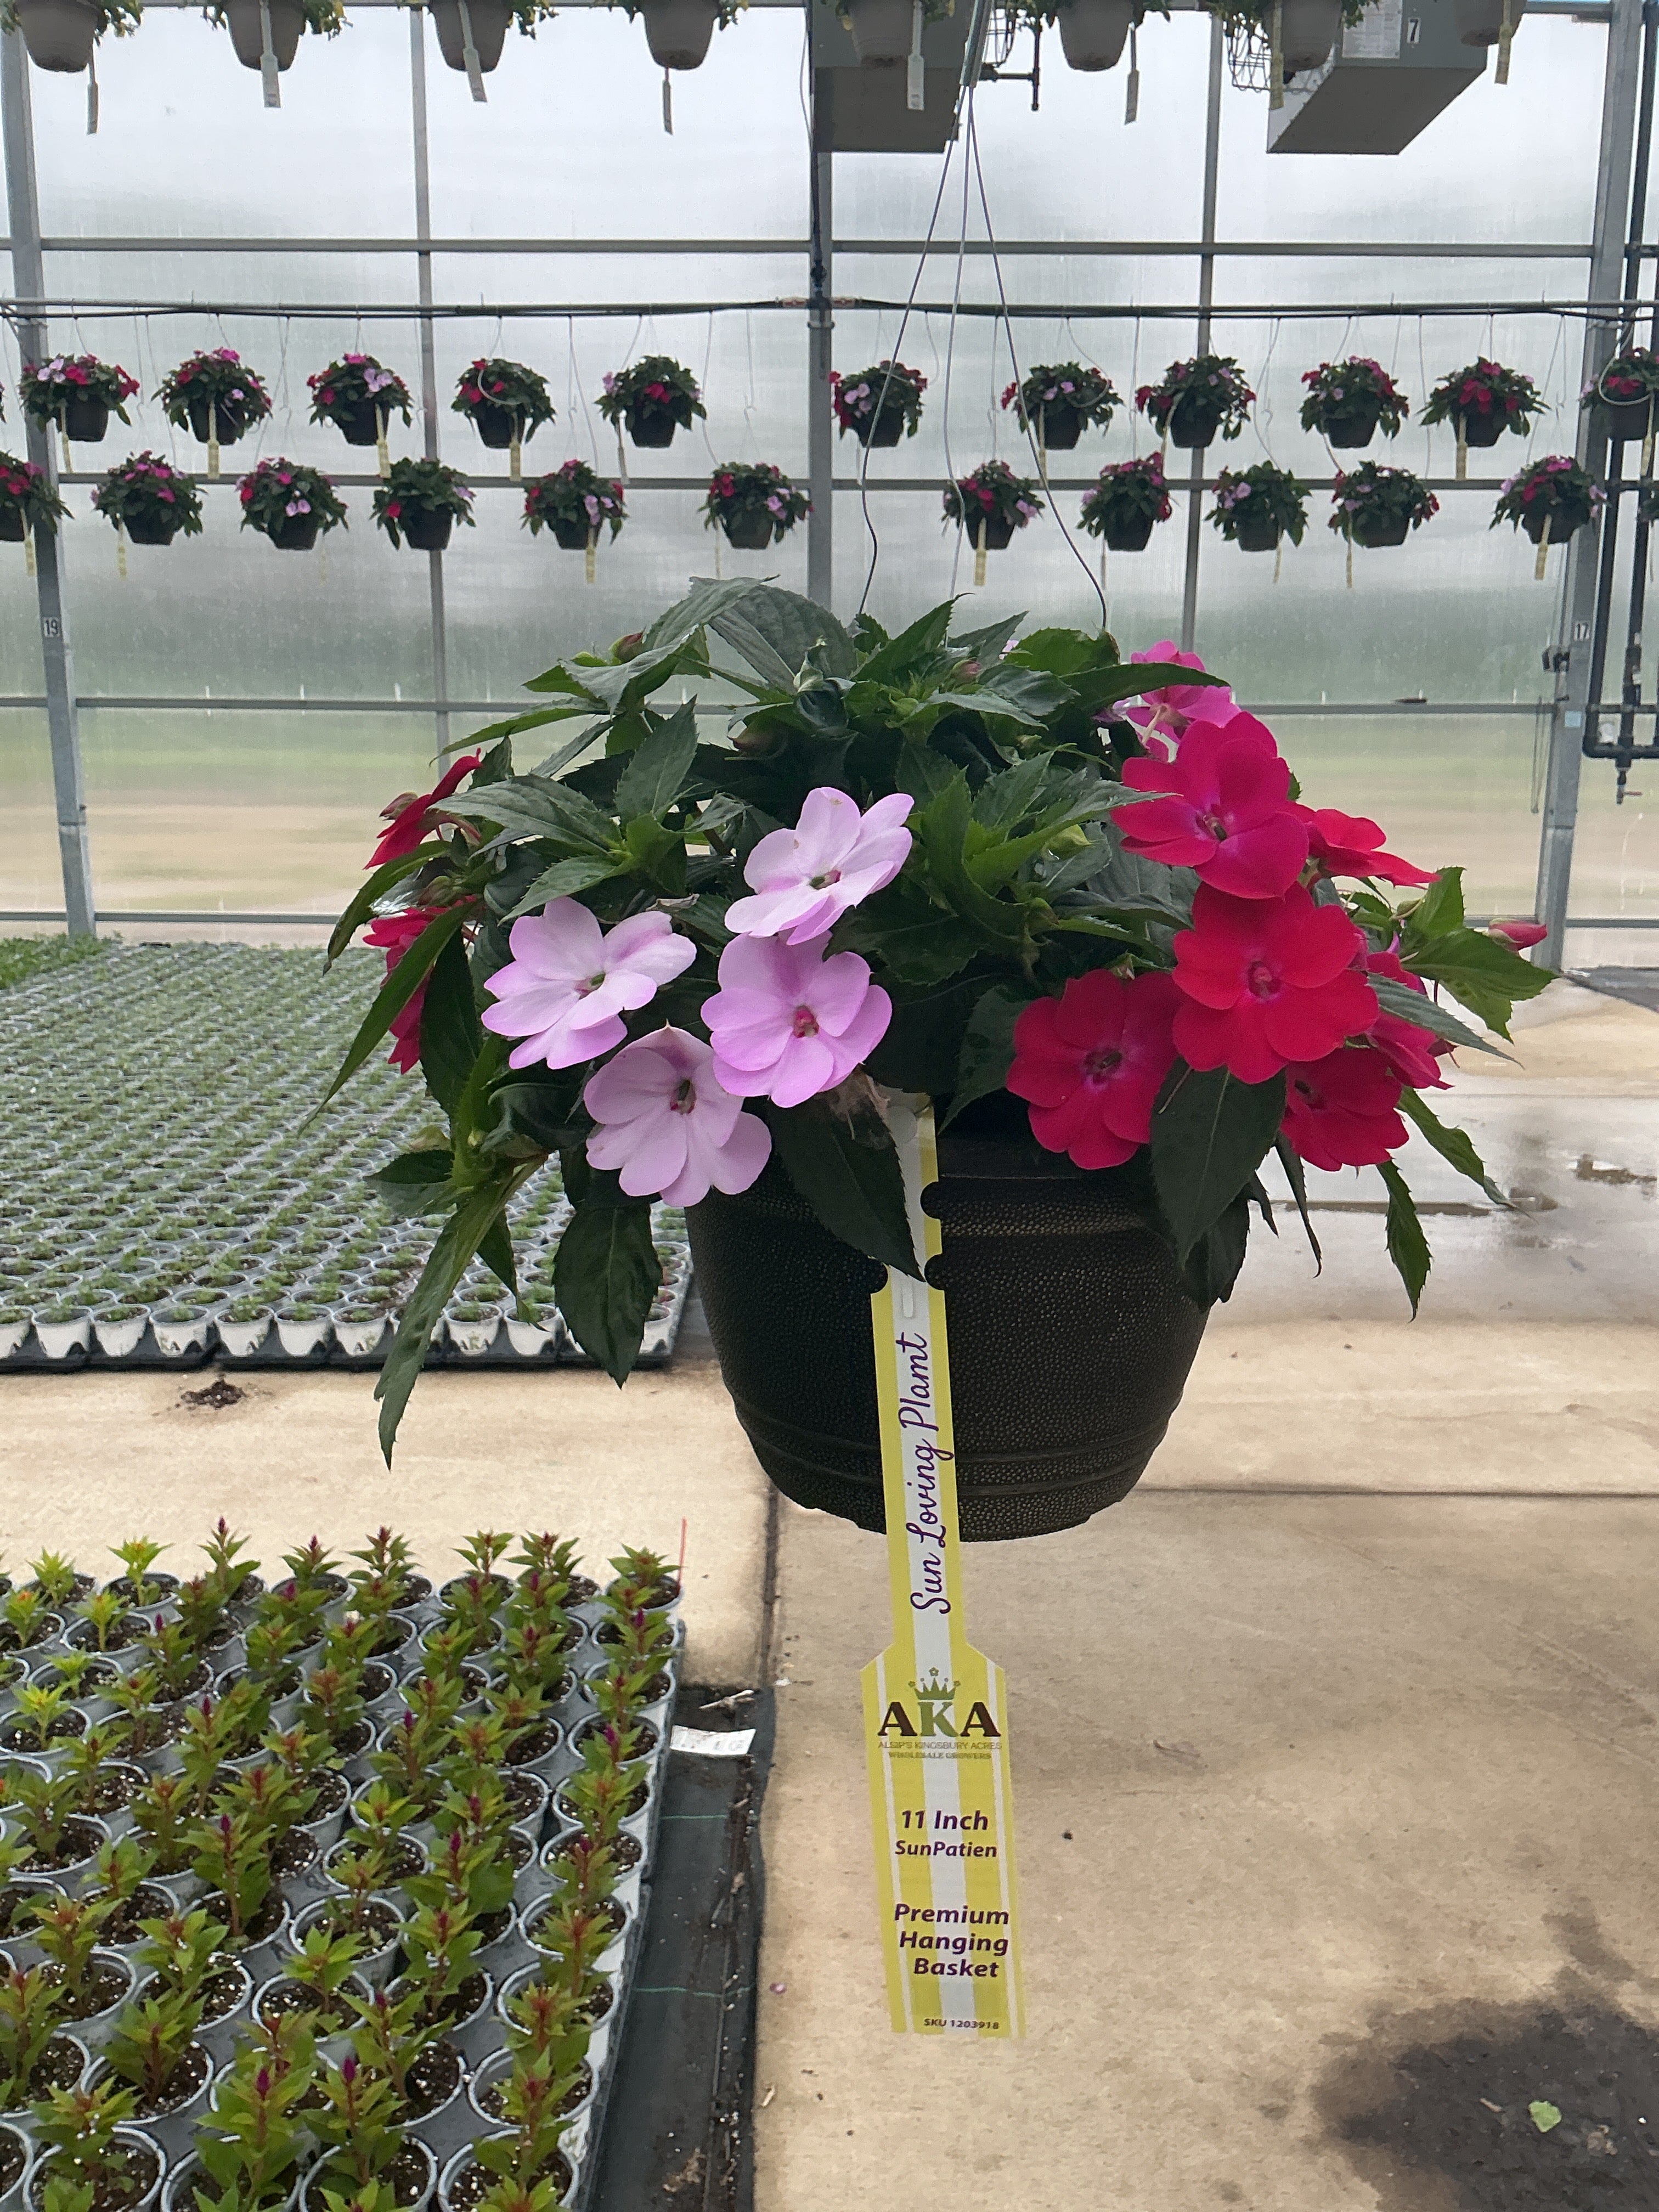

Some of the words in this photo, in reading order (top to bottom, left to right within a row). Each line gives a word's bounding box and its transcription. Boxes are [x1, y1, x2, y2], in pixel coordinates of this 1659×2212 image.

[1409, 19, 1419, 42] 7
[44, 619, 59, 636] 19
[906, 1438, 955, 1548] Loving
[910, 1551, 951, 1615] Sun
[877, 1701, 1001, 1737] AKA
[970, 1742, 1002, 1750] ACRES
[901, 1810, 926, 1829] 11
[934, 1810, 989, 1831] Inch
[894, 1839, 997, 1858] SunPatien
[894, 1903, 1009, 1925] Premium
[899, 1931, 1009, 1956] Hanging
[913, 1957, 1000, 1978] Basket
[923, 2018, 947, 2027] SKU
[950, 2019, 1000, 2029] 1203918
